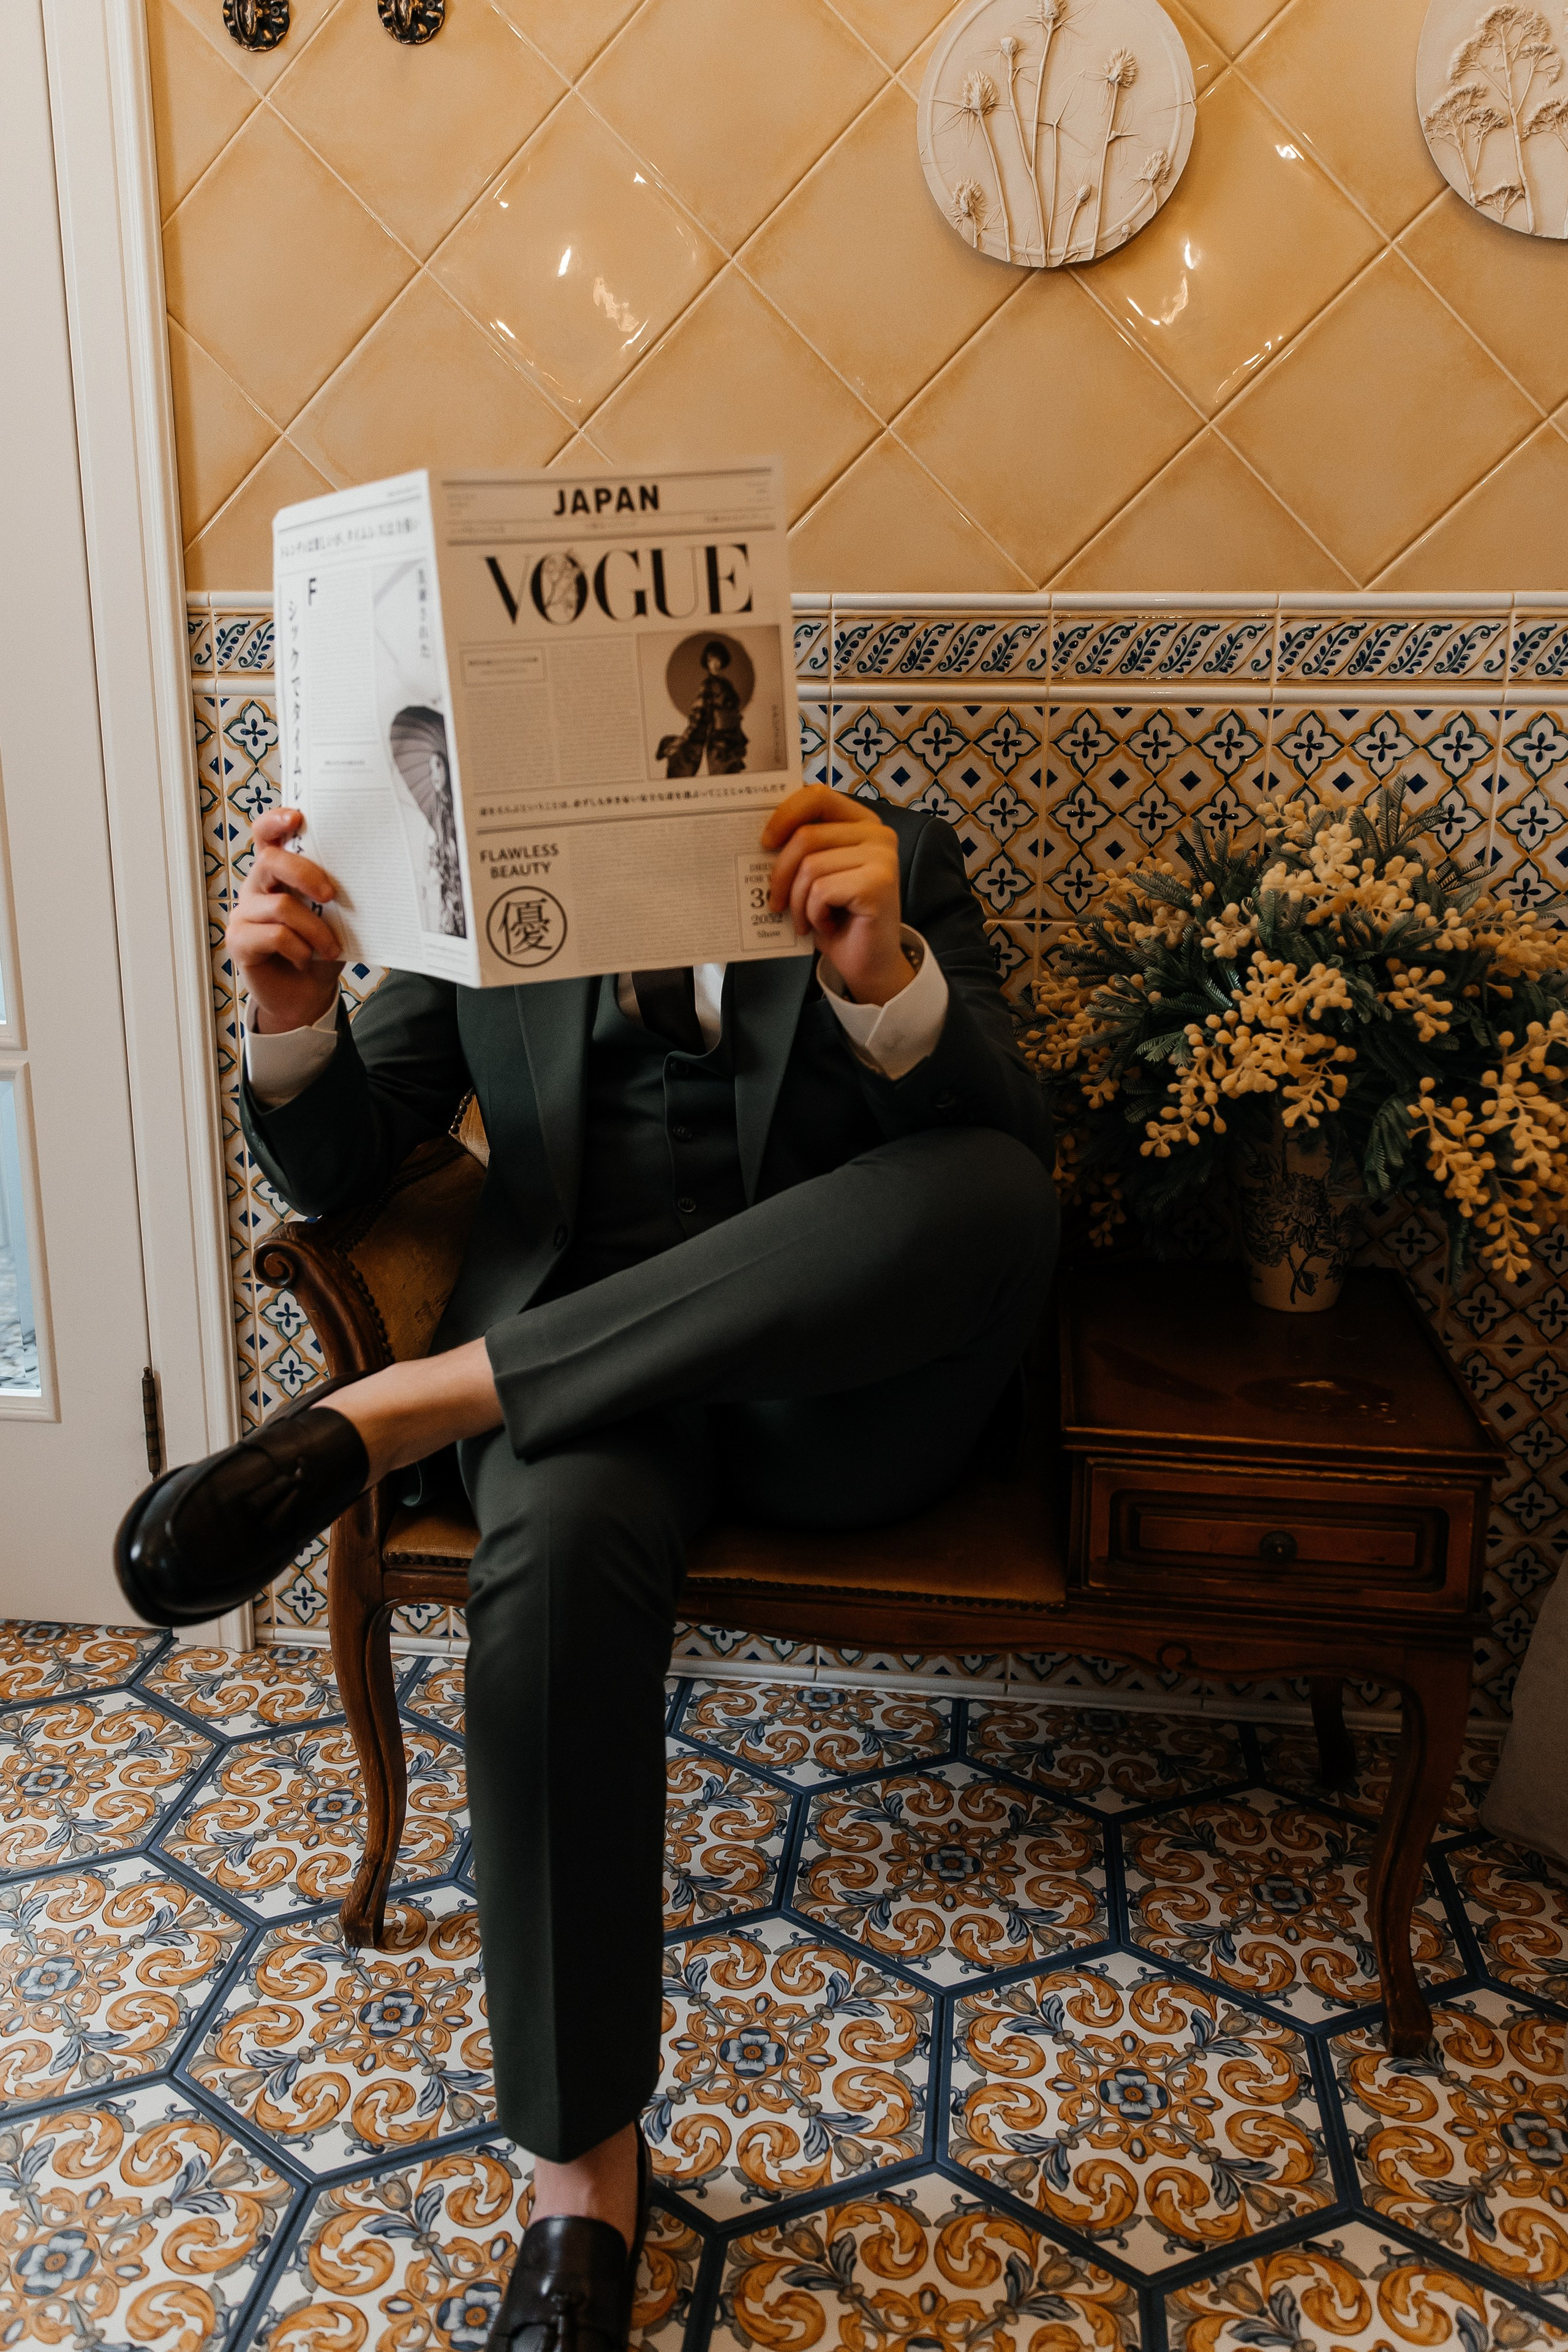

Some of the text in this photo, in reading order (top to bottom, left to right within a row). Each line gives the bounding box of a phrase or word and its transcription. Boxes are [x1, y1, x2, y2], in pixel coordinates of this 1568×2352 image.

[553, 484, 660, 516] JAPAN
[308, 577, 317, 607] F
[484, 543, 754, 627] VOGUE
[288, 600, 304, 854] シックでタイムレな
[480, 842, 560, 863] FLAWLESS
[490, 861, 551, 880] BEAUTY
[497, 897, 552, 956] 優
